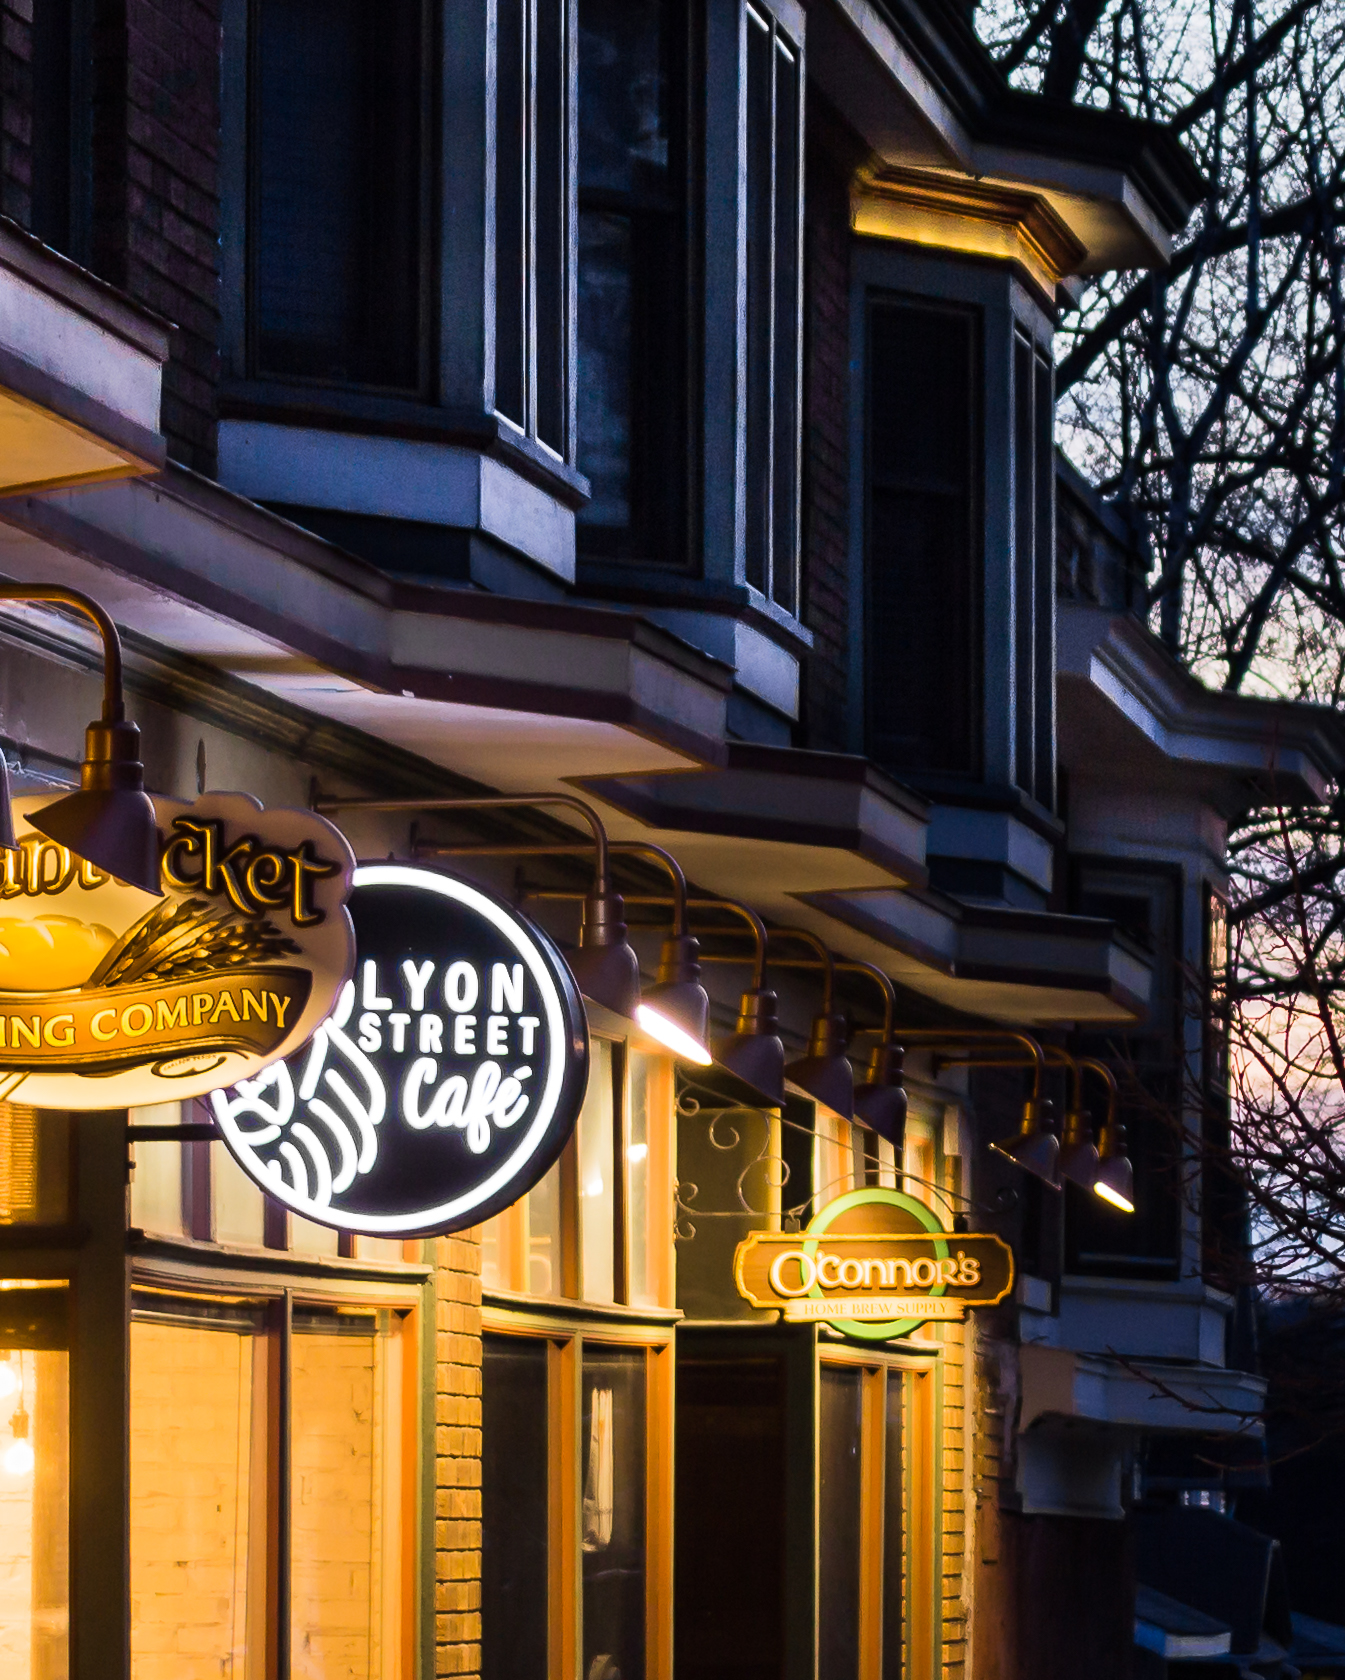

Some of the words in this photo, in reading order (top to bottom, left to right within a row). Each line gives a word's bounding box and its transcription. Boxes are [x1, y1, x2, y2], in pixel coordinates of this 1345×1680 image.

[362, 958, 525, 1014] LYON
[89, 988, 292, 1042] COMPANY
[357, 1011, 541, 1056] STREET
[402, 1056, 534, 1155] Café
[804, 1303, 848, 1315] HOME
[852, 1302, 893, 1315] BREW
[896, 1301, 949, 1315] SUPPLY
